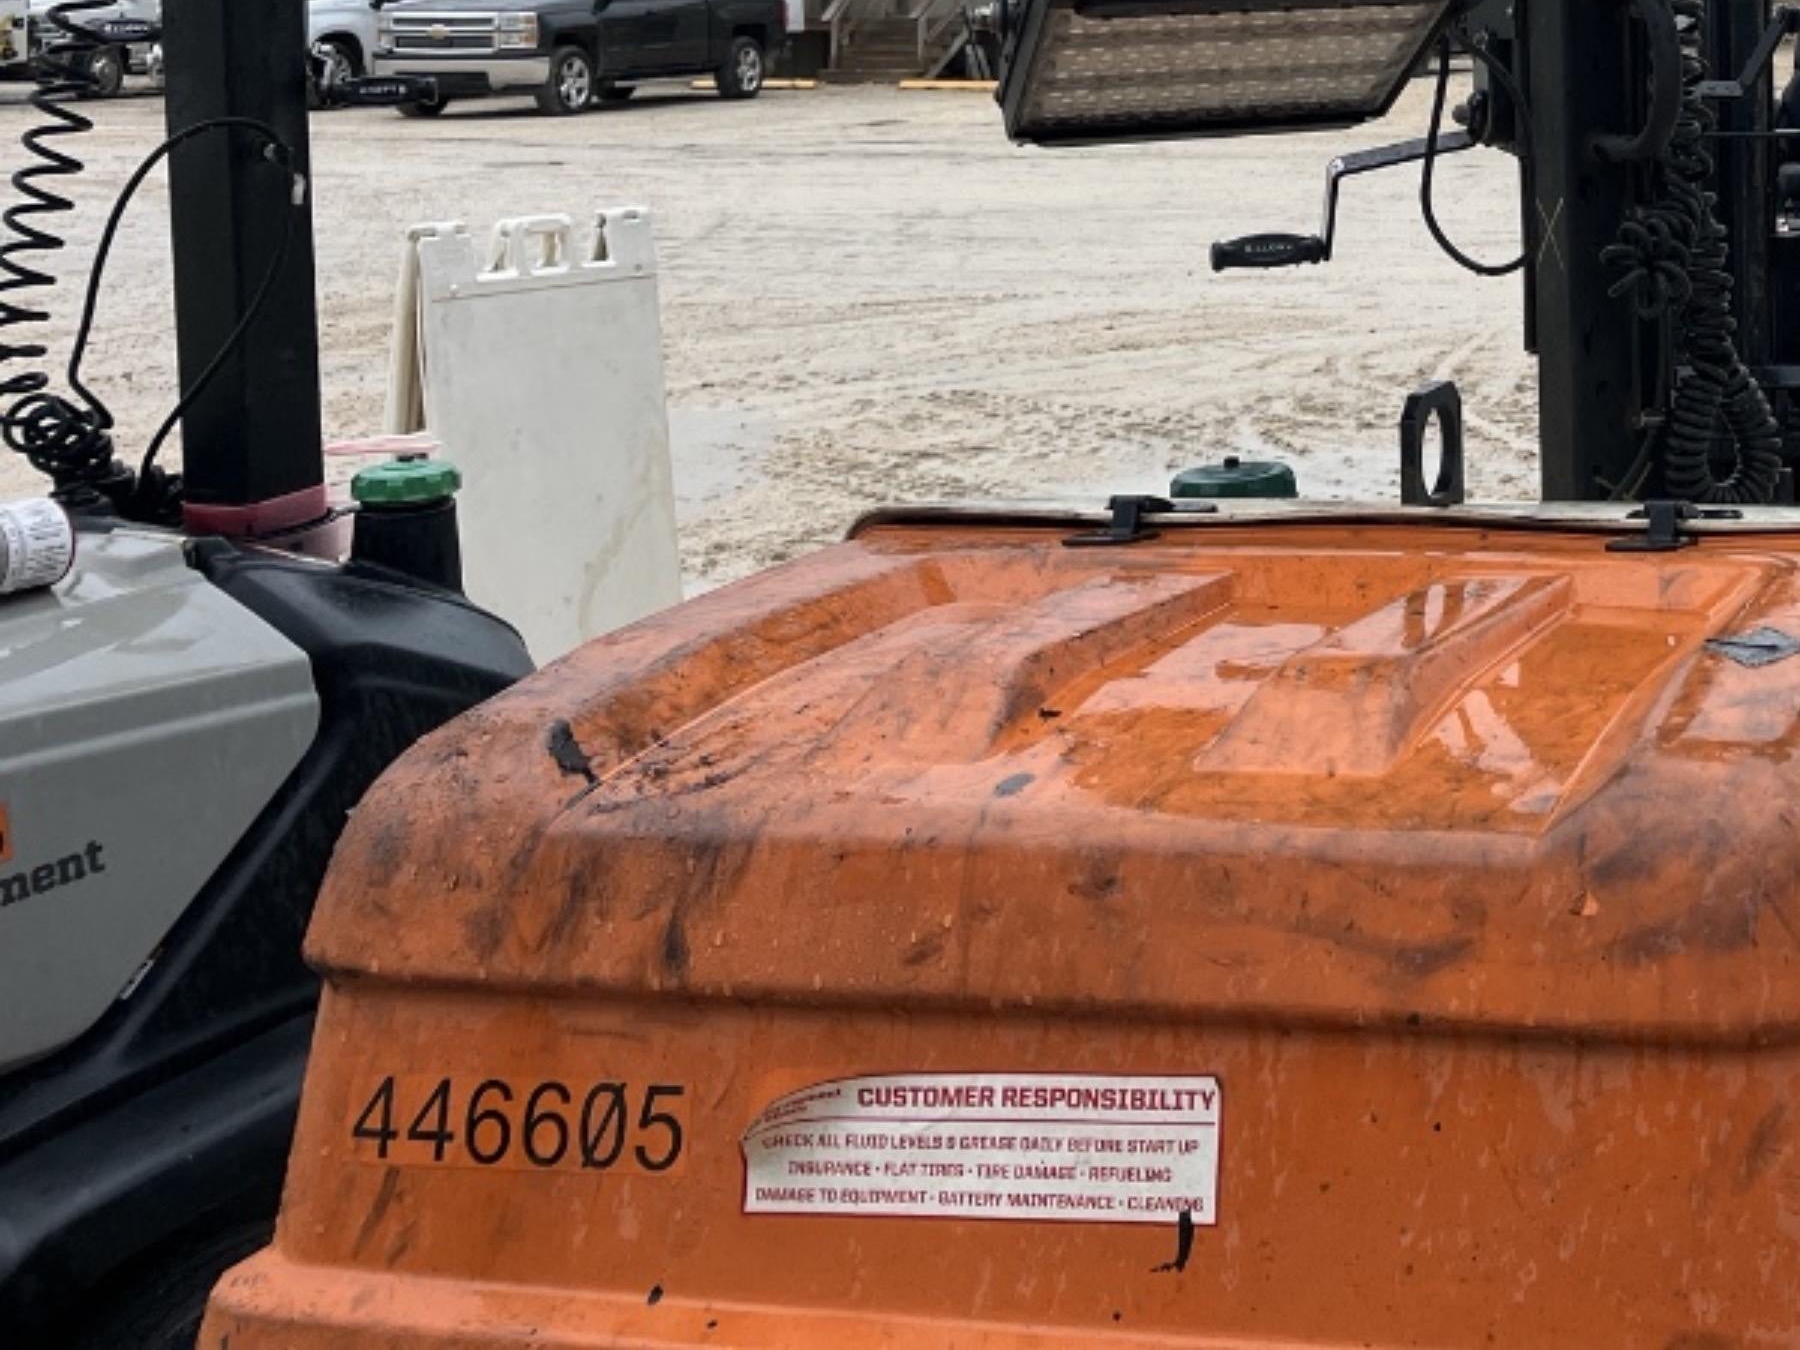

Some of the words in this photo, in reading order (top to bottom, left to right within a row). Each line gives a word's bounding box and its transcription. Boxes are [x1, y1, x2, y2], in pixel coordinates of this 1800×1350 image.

[857, 1086, 995, 1108] CUSTOMER
[1001, 1087, 1216, 1111] RESPONSIBILITY
[761, 1133, 815, 1150] CHECK
[816, 1134, 841, 1149] ALL
[845, 1135, 889, 1150] FLUID
[890, 1135, 943, 1150] LEVELS
[1019, 1137, 1062, 1152] DAILY
[1067, 1137, 1121, 1153] BEFORE
[1127, 1139, 1176, 1154] START
[1178, 1140, 1200, 1155] UP
[788, 1160, 872, 1177] INSURANCE
[884, 1161, 917, 1177] FLAT
[1013, 1164, 1077, 1180] DAMAGE
[1088, 1166, 1172, 1183] REFUELING
[755, 1187, 815, 1202] DAMAGE
[819, 1187, 838, 1202] TO
[840, 1188, 928, 1206] EQUIPMENT
[938, 1191, 1002, 1207] BATTERY
[1007, 1193, 1115, 1210] MAINTENANCE
[1127, 1196, 1204, 1212] CLEANING
